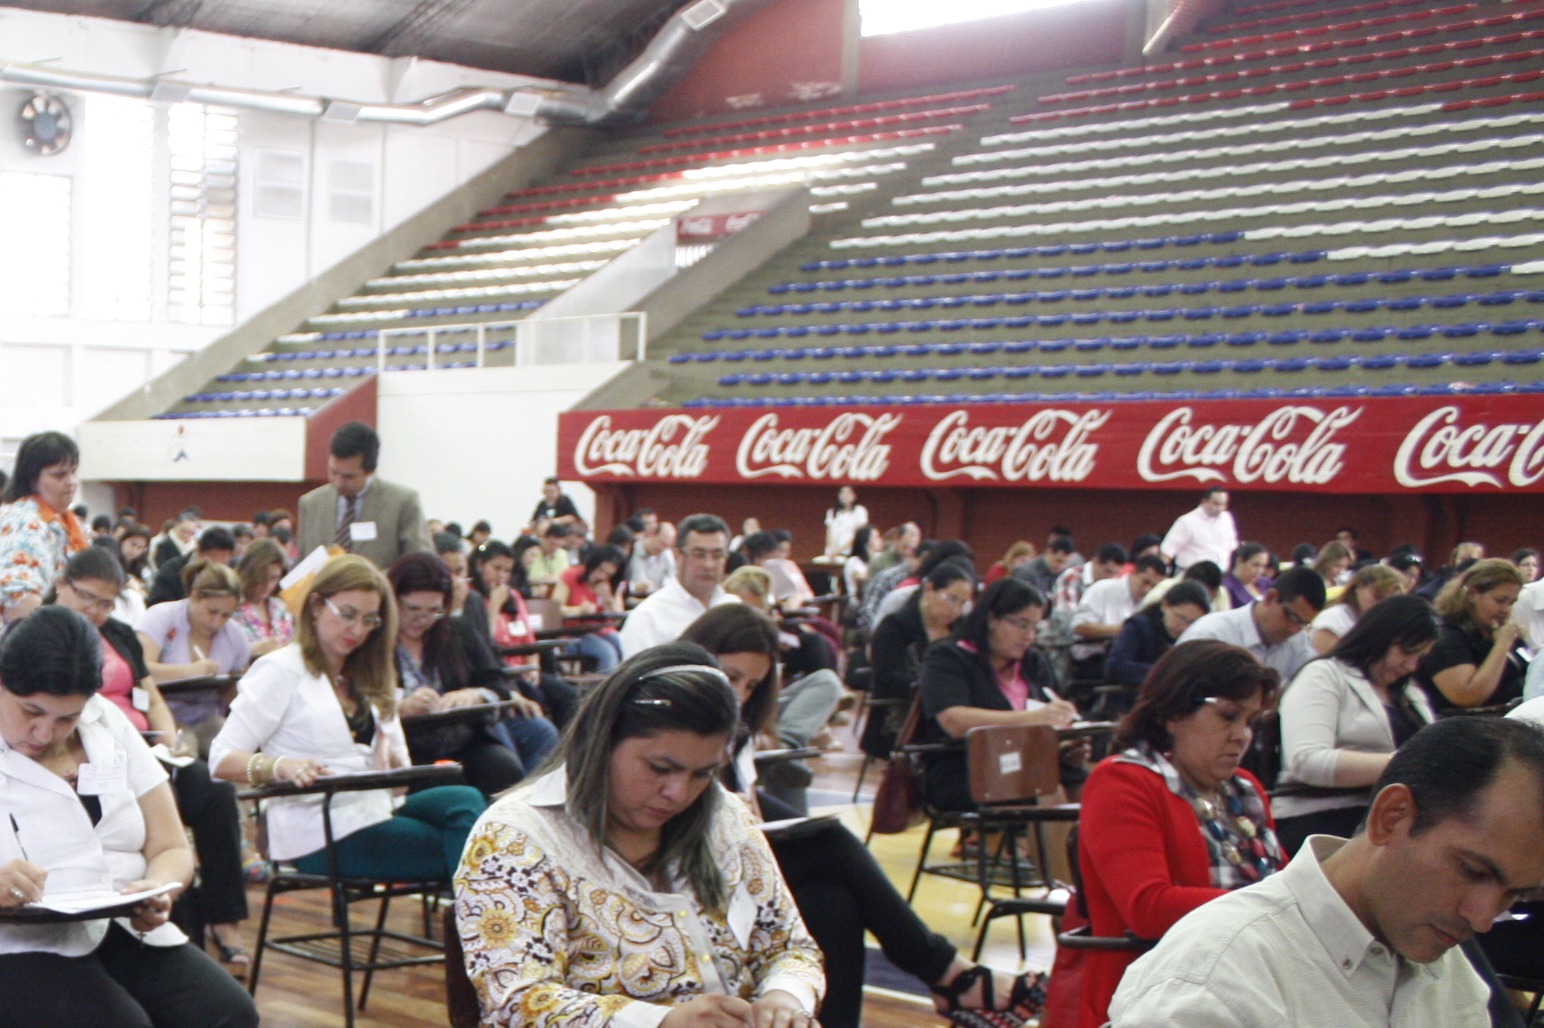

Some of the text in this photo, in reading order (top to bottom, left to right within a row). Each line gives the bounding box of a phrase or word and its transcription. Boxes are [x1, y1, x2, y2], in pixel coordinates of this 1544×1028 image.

[574, 414, 721, 478] Coca-Cola
[736, 412, 903, 481] Coca-Cola
[920, 409, 1112, 482] Coca-Cola
[1137, 406, 1363, 484] Coca-Cola
